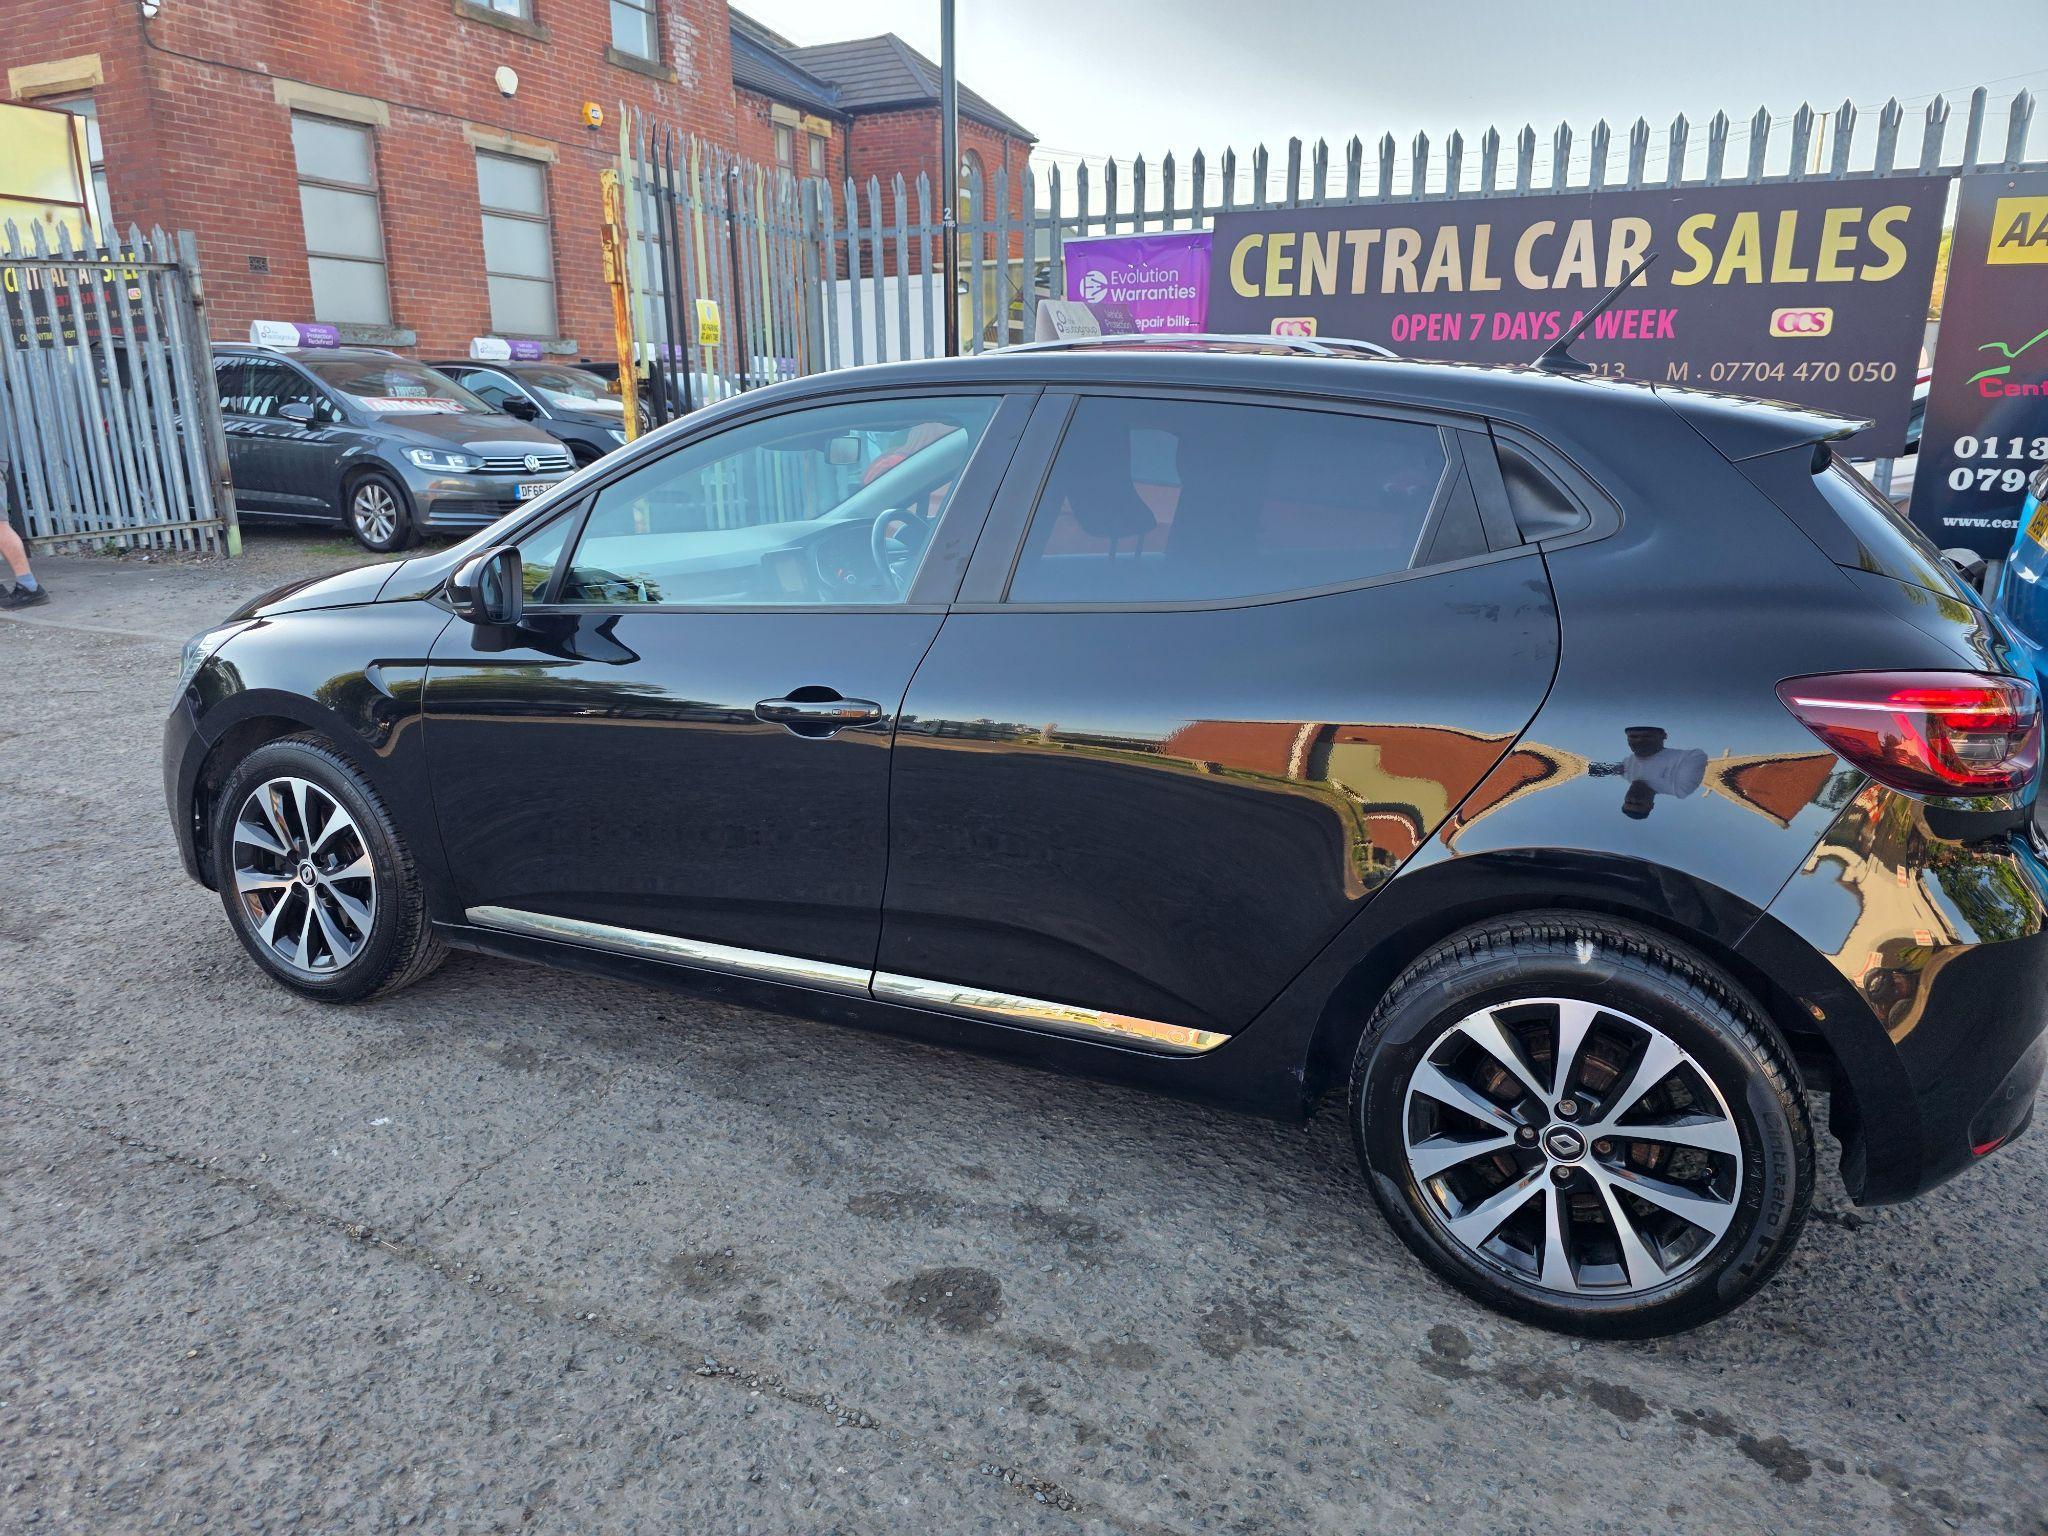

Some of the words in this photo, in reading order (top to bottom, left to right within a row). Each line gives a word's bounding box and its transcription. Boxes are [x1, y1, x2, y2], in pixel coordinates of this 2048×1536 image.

[1229, 224, 1501, 299] CENTRAL
[1513, 216, 1652, 290] CAR
[1670, 205, 1912, 286] SALES
[1111, 268, 1179, 286] Evolution
[1111, 285, 1196, 302] Warranties
[1135, 316, 1164, 333] epair
[1391, 312, 1461, 342] OPEN
[1469, 312, 1485, 341] 7
[1491, 311, 1561, 341] DAYS
[1594, 309, 1679, 339] WEEK
[1776, 311, 1826, 333] CCS
[1667, 363, 1688, 381] M
[1710, 362, 1785, 381] 07704
[1793, 362, 1840, 381] 470
[1848, 362, 1897, 382] 050
[1953, 436, 2048, 460] 0113
